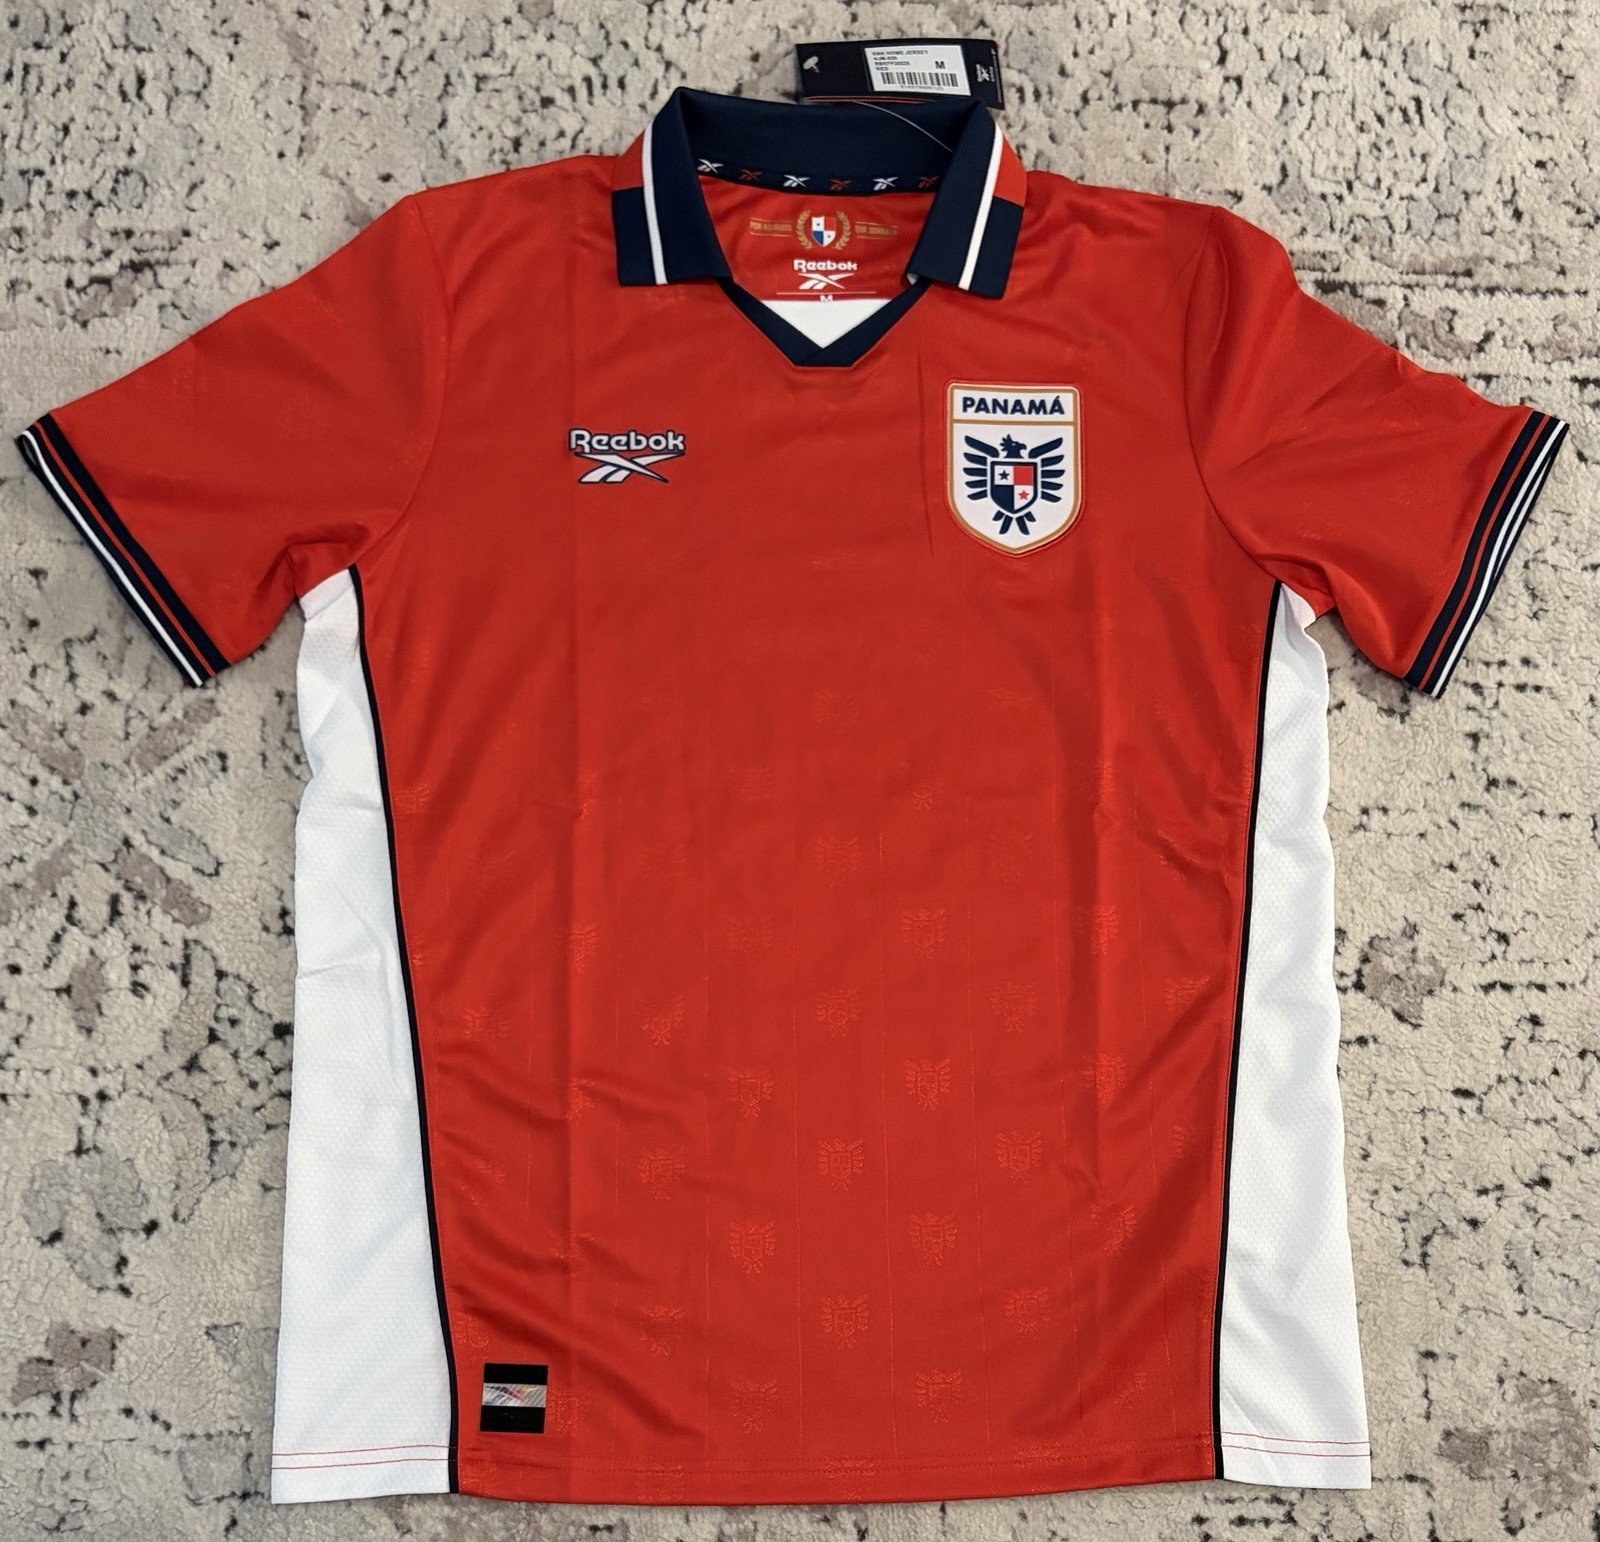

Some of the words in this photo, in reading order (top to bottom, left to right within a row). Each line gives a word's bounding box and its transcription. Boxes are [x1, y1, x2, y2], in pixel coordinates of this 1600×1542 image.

[934, 61, 946, 69] M
[793, 259, 858, 273] Reebok
[962, 395, 1065, 415] PANAMÁ
[569, 428, 686, 454] Reebok
